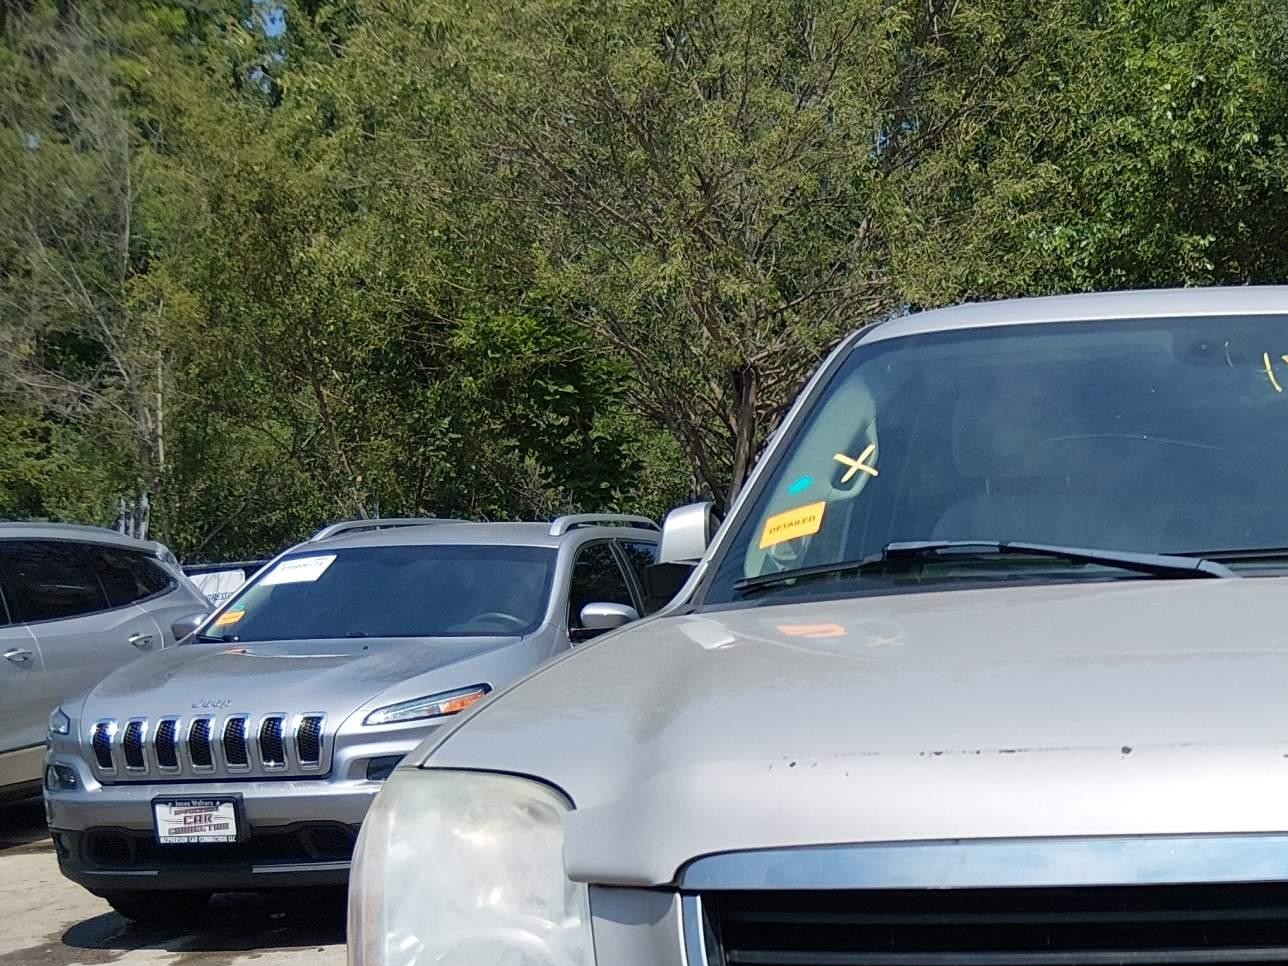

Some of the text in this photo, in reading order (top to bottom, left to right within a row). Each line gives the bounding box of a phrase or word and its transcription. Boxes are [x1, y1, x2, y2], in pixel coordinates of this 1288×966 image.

[769, 515, 816, 535] DETAILED
[192, 697, 232, 710] Jeep
[183, 814, 213, 825] CAR
